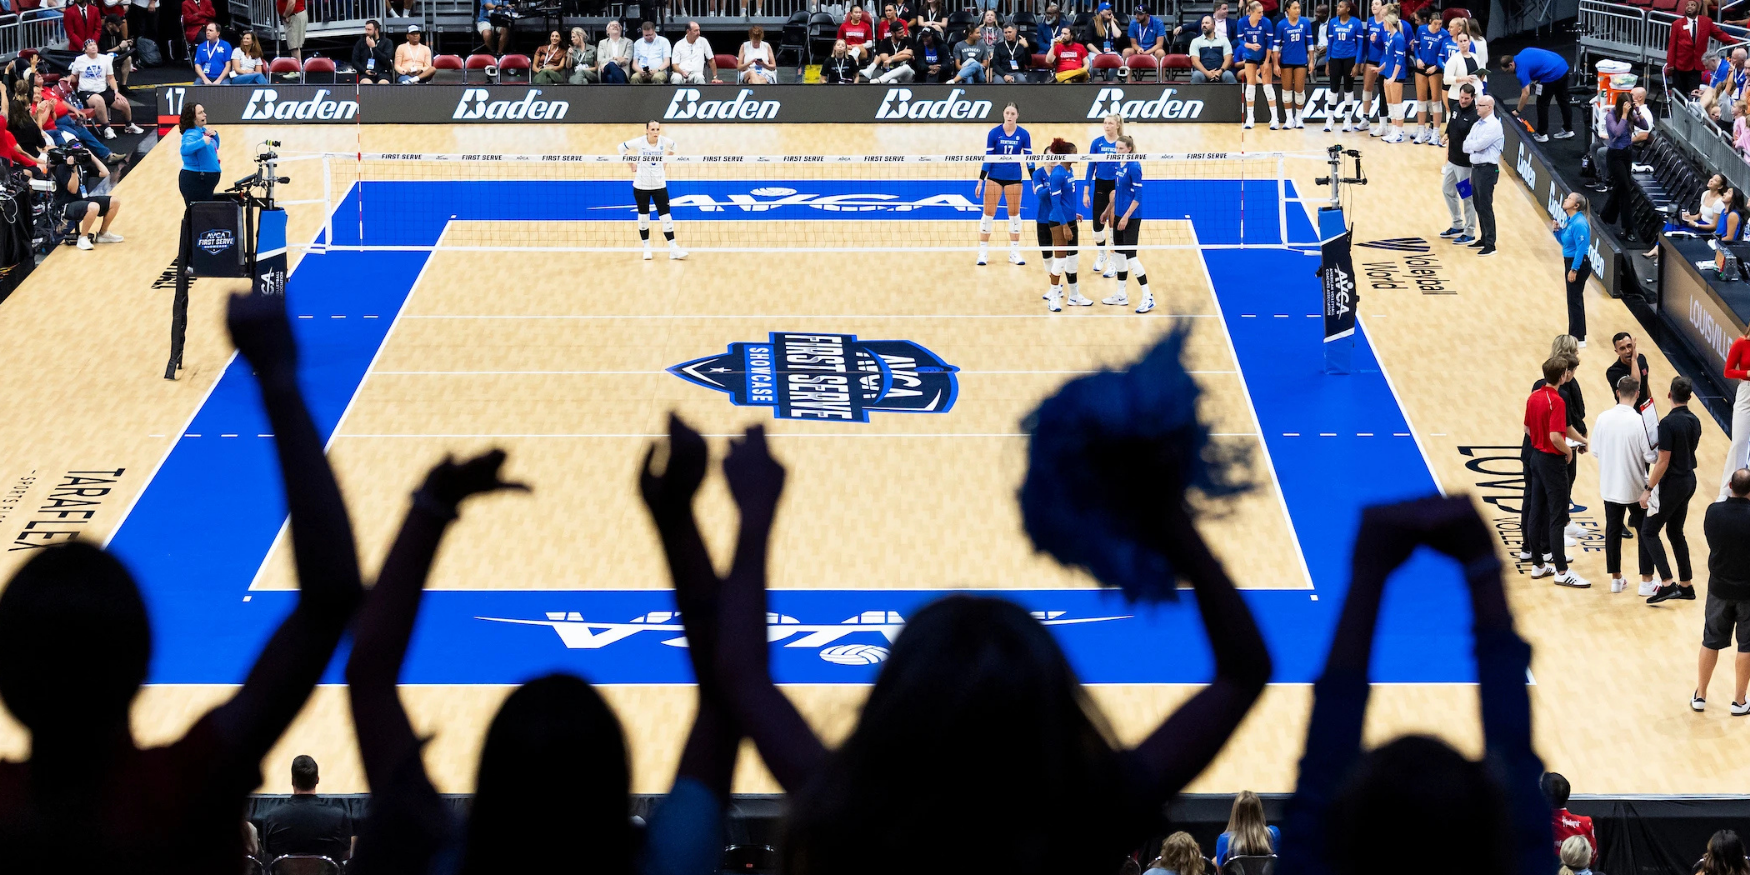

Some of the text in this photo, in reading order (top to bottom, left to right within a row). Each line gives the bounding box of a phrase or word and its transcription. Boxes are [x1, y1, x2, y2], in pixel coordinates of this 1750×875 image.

[1290, 34, 1300, 42] 20
[1338, 32, 1346, 41] 10
[1428, 42, 1434, 50] 7
[165, 87, 186, 116] 17
[241, 89, 358, 120] Baden
[452, 88, 570, 120] Baden
[663, 88, 781, 119] Baden
[875, 88, 993, 119] Baden
[1087, 88, 1205, 119] Baden
[1301, 87, 1420, 119] Badn
[1004, 145, 1014, 154] 17
[629, 194, 981, 212] AVCA
[1548, 180, 1568, 228] Bade
[1402, 254, 1458, 295] Volleyball
[1588, 238, 1606, 280] aden
[1335, 268, 1350, 315] AVCA
[1362, 262, 1408, 290] World
[748, 347, 774, 402] SHOWCASE
[784, 334, 852, 419] FIRST SERVE
[856, 352, 923, 398] AVCA
[3, 477, 36, 502] SPORTS
